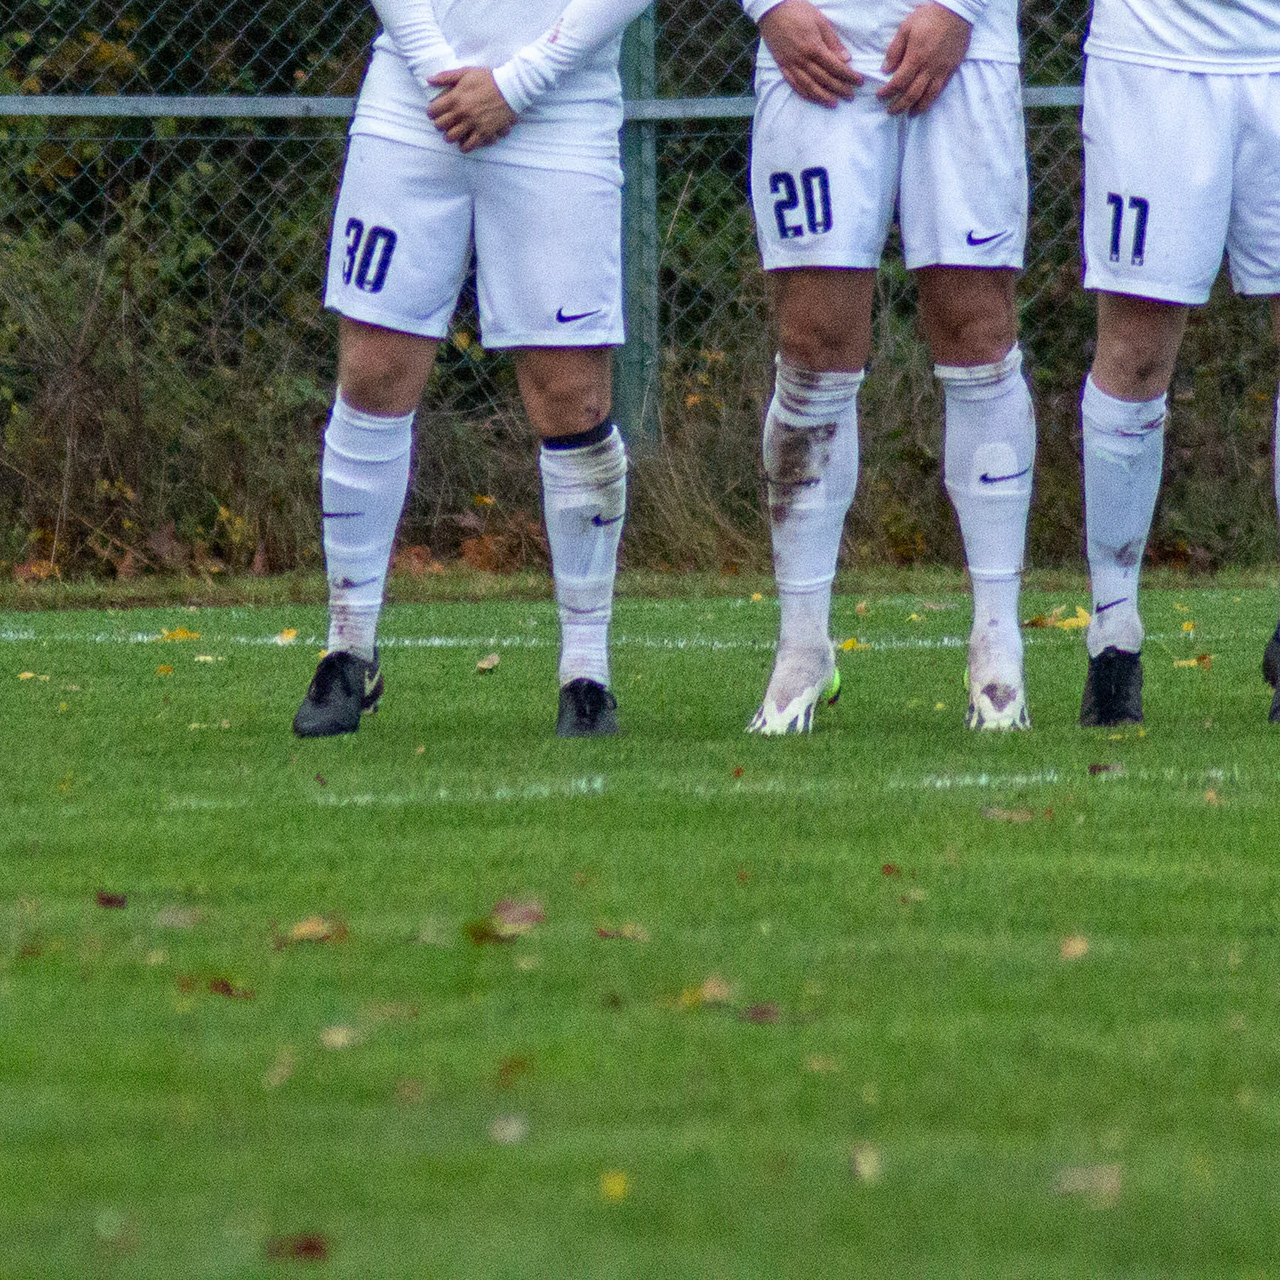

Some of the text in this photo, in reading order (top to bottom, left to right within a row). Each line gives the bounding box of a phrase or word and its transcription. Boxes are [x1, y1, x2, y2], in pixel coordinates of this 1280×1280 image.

[769, 166, 833, 239] 20
[1106, 192, 1150, 266] 11
[342, 217, 398, 293] 30
